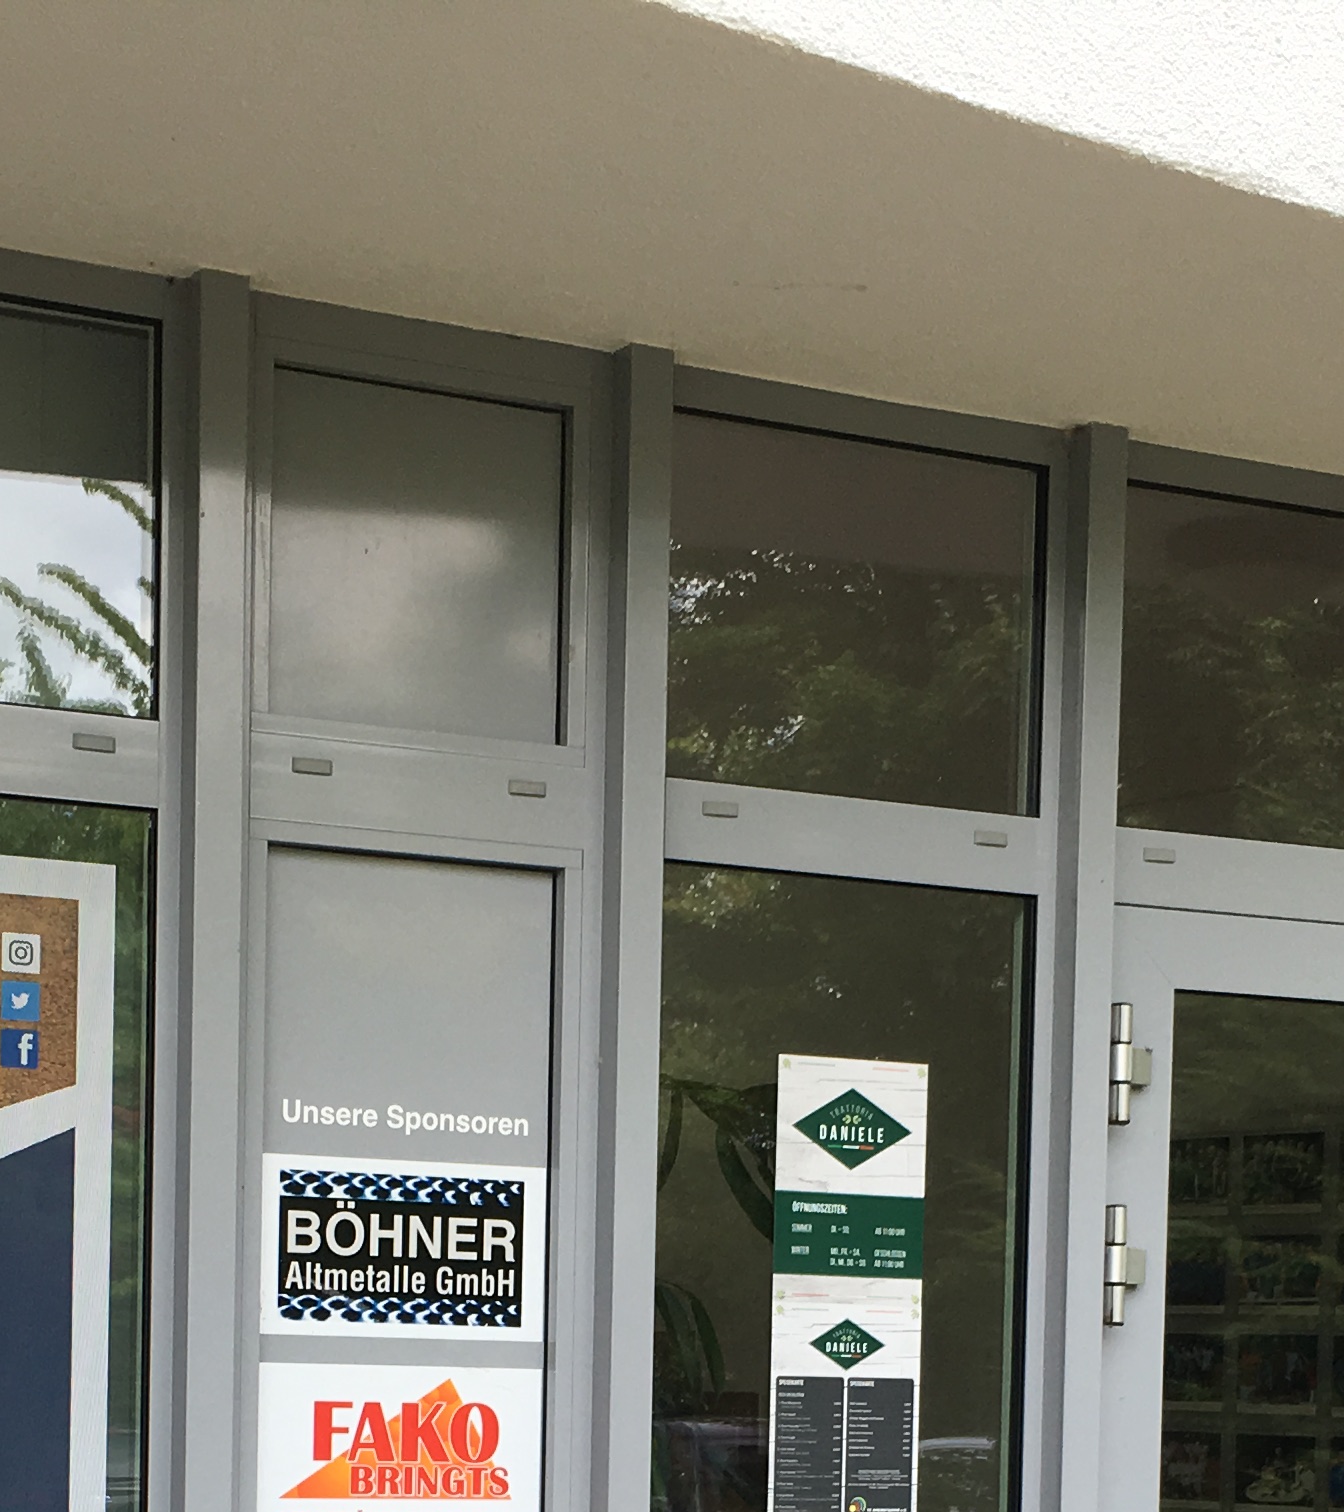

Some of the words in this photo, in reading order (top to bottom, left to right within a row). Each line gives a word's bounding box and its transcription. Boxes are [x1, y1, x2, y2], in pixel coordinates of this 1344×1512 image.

[282, 1098, 378, 1128] Unsere
[386, 1104, 530, 1137] Sponsoren
[819, 1124, 886, 1144] DANIELE
[287, 1200, 516, 1263] BÖHNER
[284, 1261, 426, 1294] Altmetalle
[436, 1266, 515, 1297] GmbH
[825, 1341, 868, 1354] DANIELE
[312, 1400, 501, 1463] FAKO
[349, 1466, 511, 1497] BRINGTS
